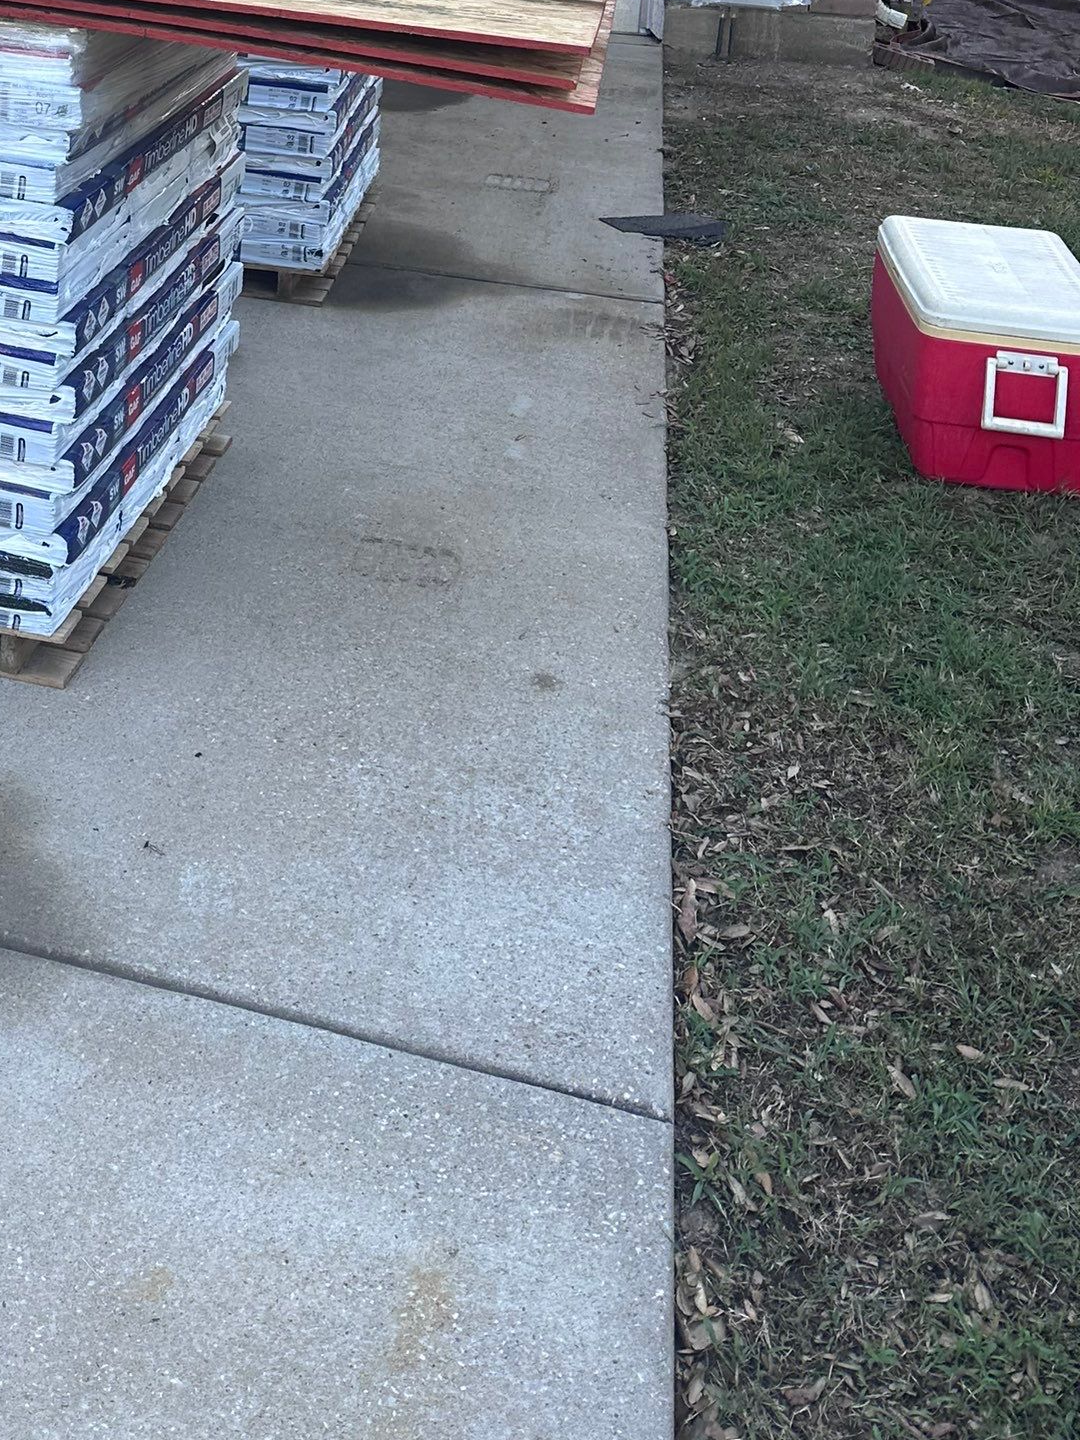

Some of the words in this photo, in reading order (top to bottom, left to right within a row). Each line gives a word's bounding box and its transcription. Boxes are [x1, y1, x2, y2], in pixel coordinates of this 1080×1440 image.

[128, 396, 140, 416] GAF
[109, 478, 121, 501] SW
[124, 465, 136, 486] GAF
